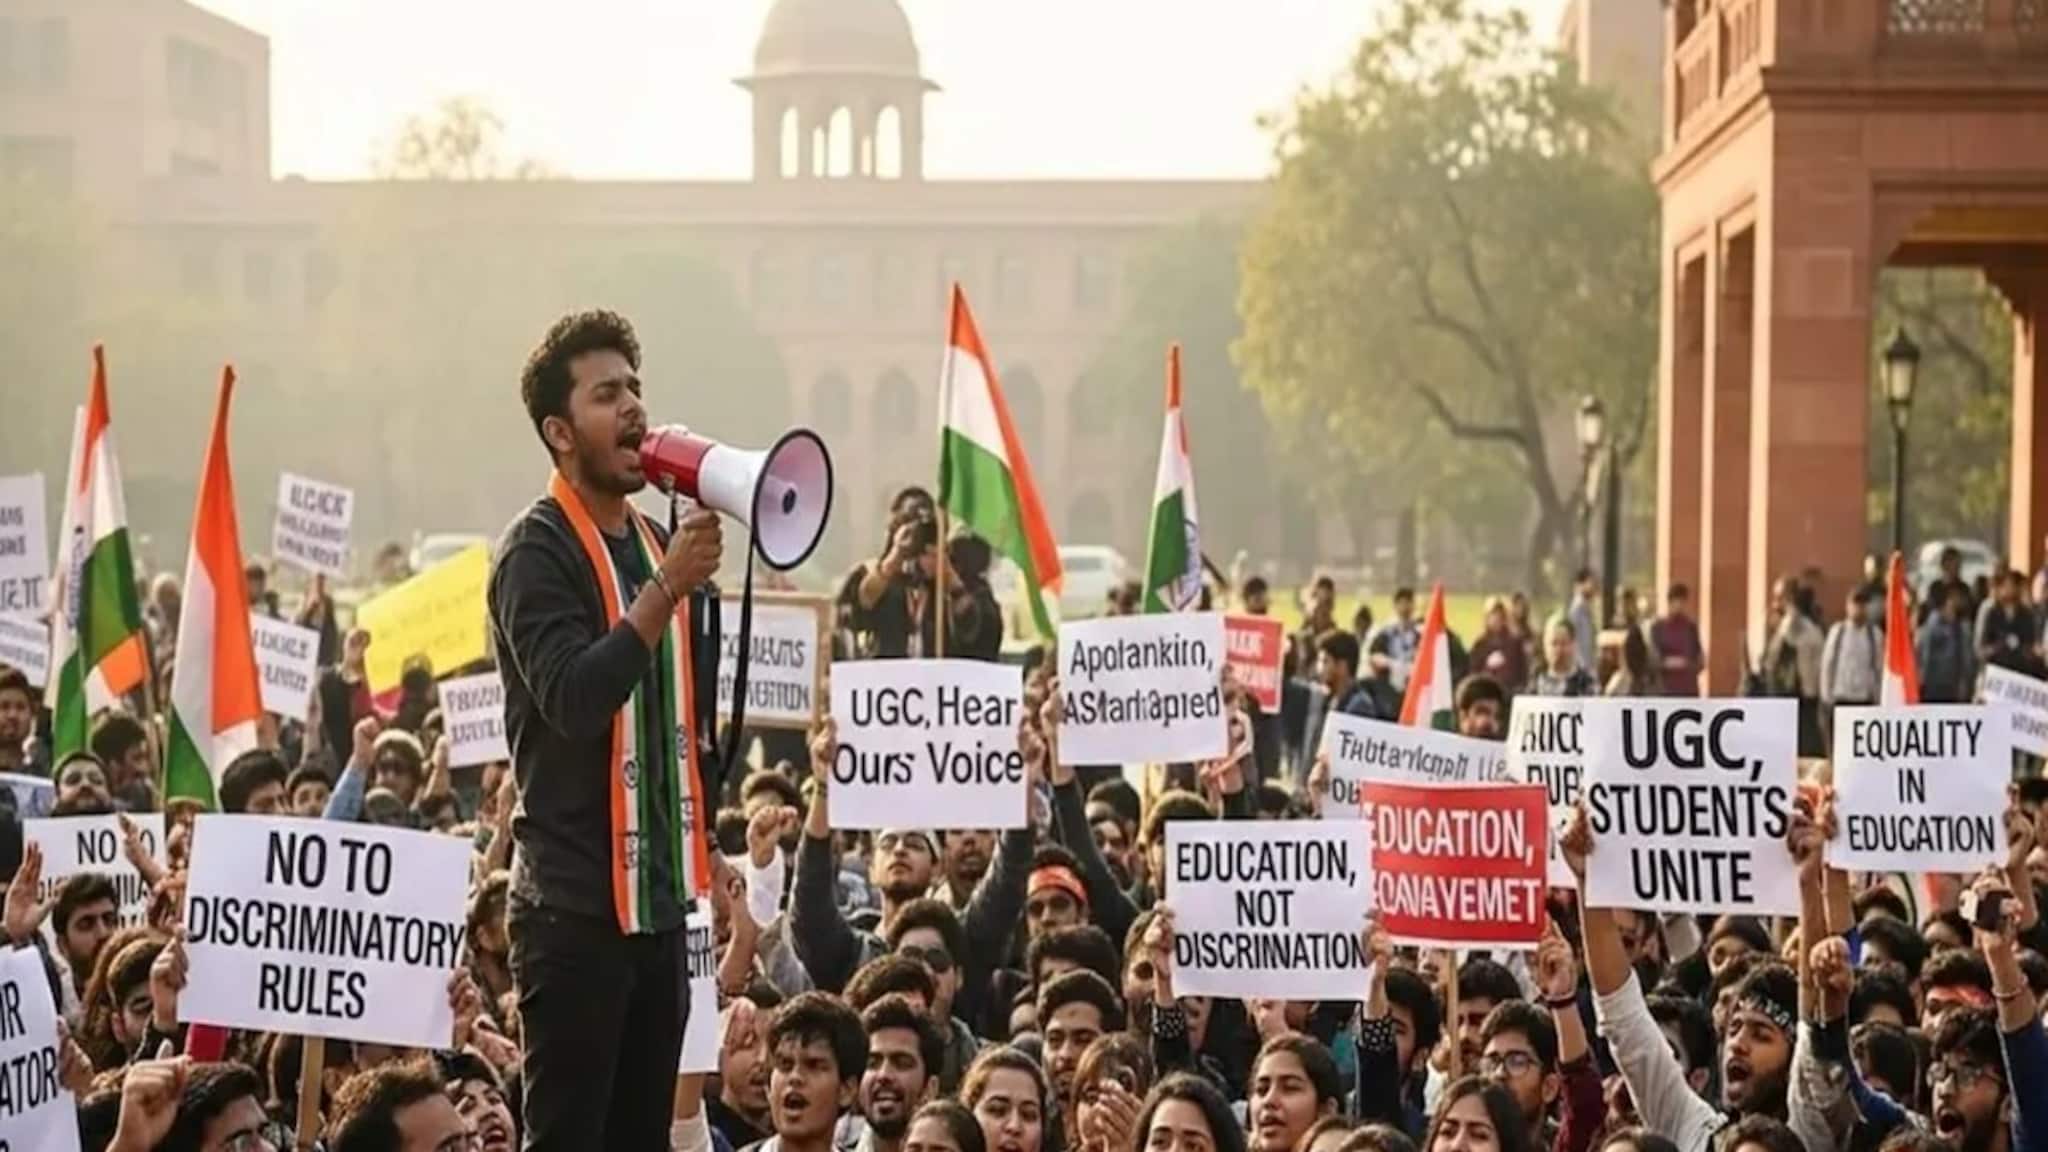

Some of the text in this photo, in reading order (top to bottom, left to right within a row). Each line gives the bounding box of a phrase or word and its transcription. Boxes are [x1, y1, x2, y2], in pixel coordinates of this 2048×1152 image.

[851, 687, 931, 730] UGC,
[937, 685, 1017, 727] Hear
[926, 740, 1024, 785] Voice
[1621, 708, 1764, 783] UGC,
[1852, 718, 1983, 762] EQUALITY
[1898, 767, 1926, 804] IN
[1588, 782, 1788, 839] STUDENTS
[76, 828, 117, 865] NO
[1847, 814, 1996, 854] EDUCATION
[265, 830, 393, 896] NO TO
[1176, 840, 1357, 888] EDUCATION,
[1631, 847, 1754, 904] UNITE
[1235, 889, 1295, 927] NOT
[187, 896, 466, 970] DISCRIMINATORY
[258, 962, 368, 1020] RULES
